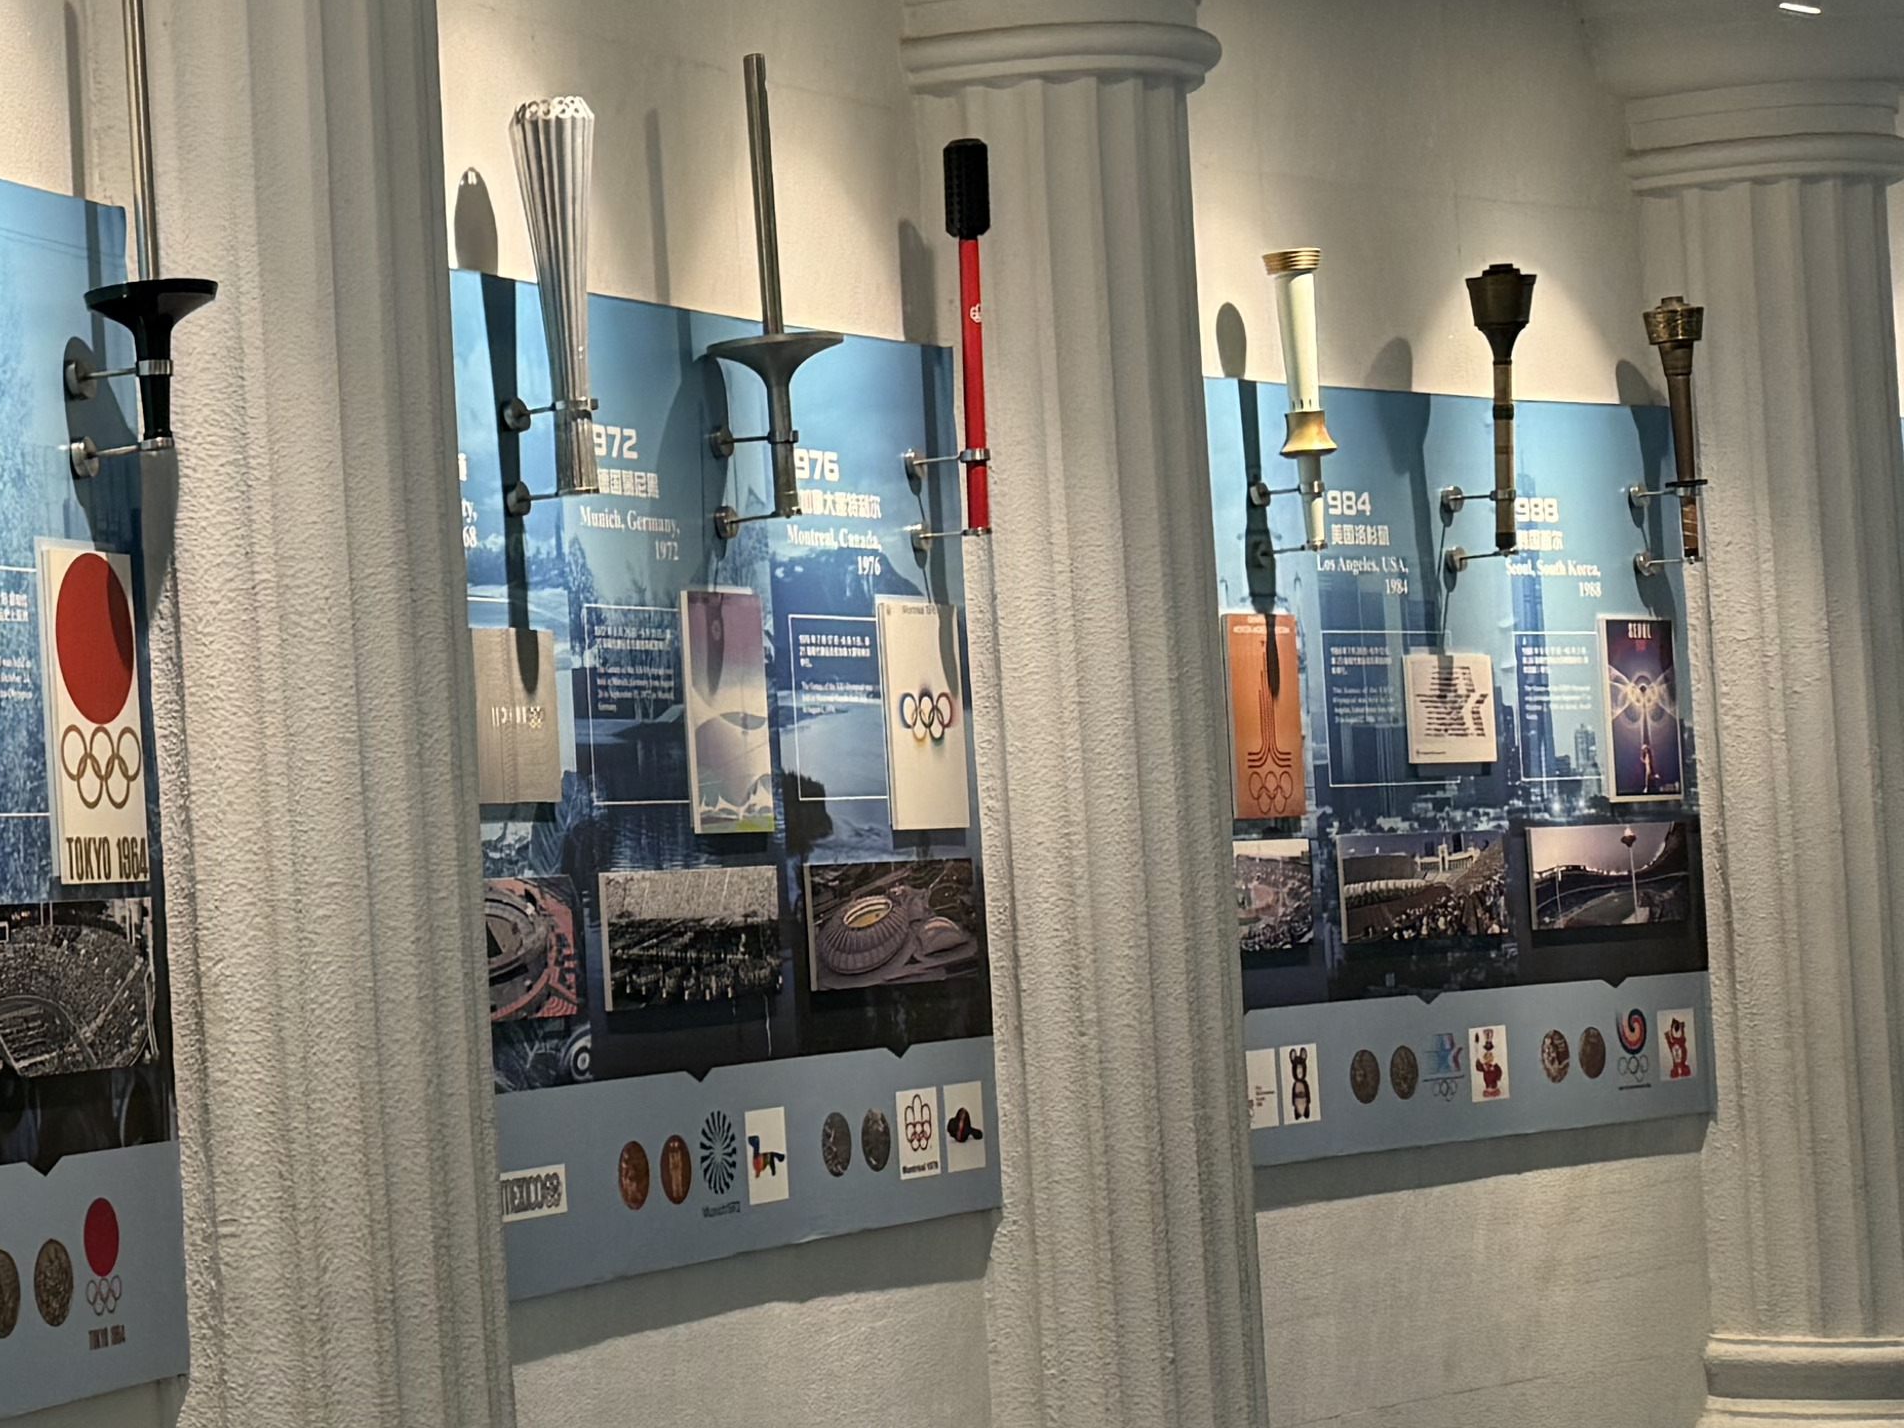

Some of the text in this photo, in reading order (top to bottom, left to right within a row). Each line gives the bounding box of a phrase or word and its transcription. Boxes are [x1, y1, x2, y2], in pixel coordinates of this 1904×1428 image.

[592, 423, 638, 460] 972
[793, 448, 840, 482] 976
[1327, 490, 1371, 516] 984
[1514, 497, 1559, 523] 988
[580, 505, 680, 538] Munich, Germany,
[655, 540, 680, 561] 1972
[786, 524, 882, 553] Montreal, Canada,
[857, 555, 882, 576] 1976
[1316, 554, 1409, 575] Los Angeles, USA,
[1505, 557, 1601, 578] Seoul, South Korea,
[1385, 579, 1409, 595] 1984
[1628, 623, 1651, 639] SEOUL
[67, 837, 148, 880] TOKYO 1964
